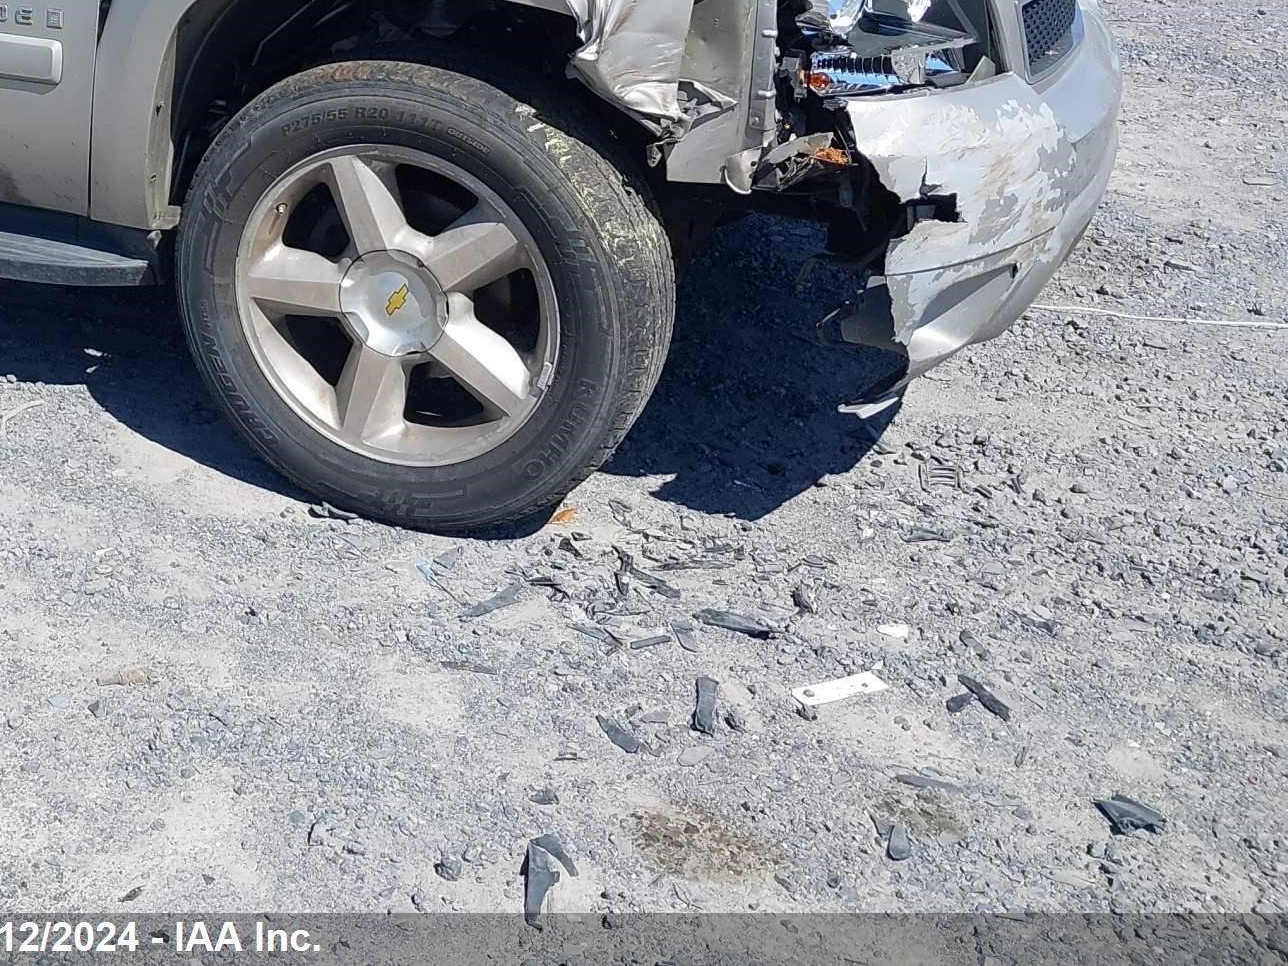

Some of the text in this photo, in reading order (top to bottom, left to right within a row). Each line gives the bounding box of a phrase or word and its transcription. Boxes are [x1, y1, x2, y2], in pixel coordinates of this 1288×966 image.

[280, 107, 348, 136] P275/55
[354, 106, 390, 121] R20
[446, 128, 493, 155] OUTSIDE
[202, 332, 281, 446] CRUGEN
[522, 377, 599, 477] KUMHO
